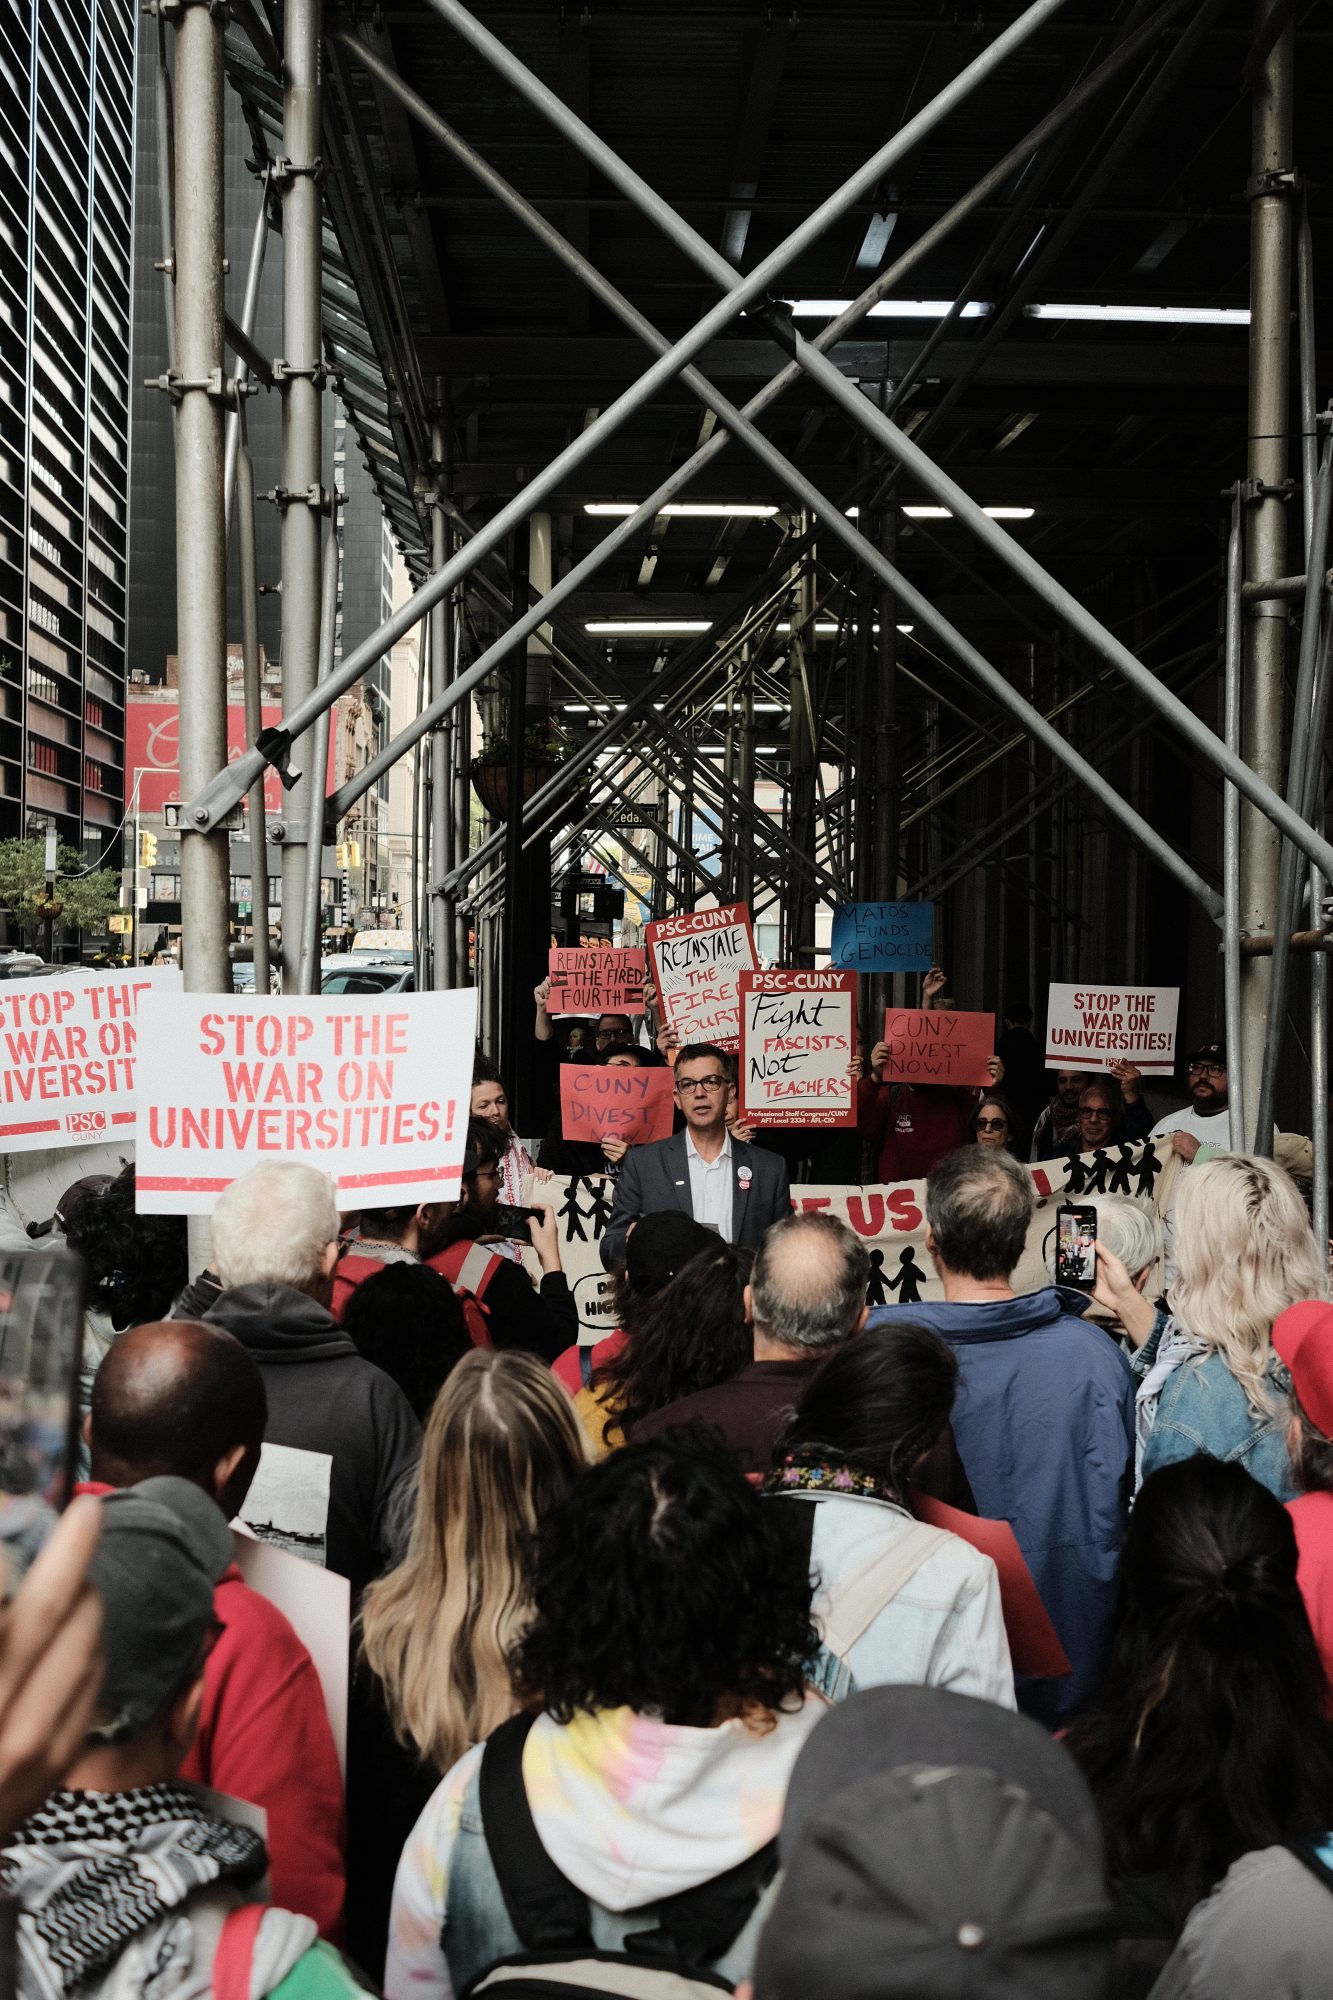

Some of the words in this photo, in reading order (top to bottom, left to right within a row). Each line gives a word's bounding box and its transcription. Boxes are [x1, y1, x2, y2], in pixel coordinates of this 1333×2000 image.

[656, 908, 737, 938] PSC-CUNY
[836, 905, 909, 924] MATOS
[855, 924, 910, 939] FUNDS
[557, 952, 632, 970] REINSTATE
[656, 927, 745, 973] REINSTATE
[841, 942, 932, 963] GENOCIDE
[568, 970, 602, 987] THE
[607, 968, 643, 985] FIRED
[685, 967, 718, 987] THE
[752, 974, 845, 989] PSC-CUNY
[561, 988, 622, 1009] FOURTH
[1073, 992, 1120, 1012] STOP
[1125, 994, 1156, 1013] THE
[672, 1007, 740, 1042] FOURT
[752, 992, 841, 1039] Fight
[890, 1014, 958, 1038] CUNY
[1082, 1012, 1123, 1031] WAR
[1128, 1013, 1150, 1031] ON
[4, 1026, 88, 1065] WAR
[200, 1013, 313, 1056] STOP
[326, 1013, 409, 1056] THE
[1051, 1028, 1172, 1051] UNIVERSITIES!
[889, 1040, 968, 1058] DIVEST
[0, 1057, 137, 1103] IVERSIT
[750, 1053, 809, 1084] Not
[222, 1061, 323, 1103] WAR
[337, 1060, 394, 1102] ON
[574, 1073, 650, 1099] CUNY
[763, 1078, 851, 1097] TEACHERS
[66, 1111, 106, 1132] PSC
[149, 1100, 456, 1150] UNIVERSITIES!
[570, 1101, 655, 1126] DIVEST
[72, 1131, 104, 1142] CUNY
[846, 1188, 923, 1237] US
